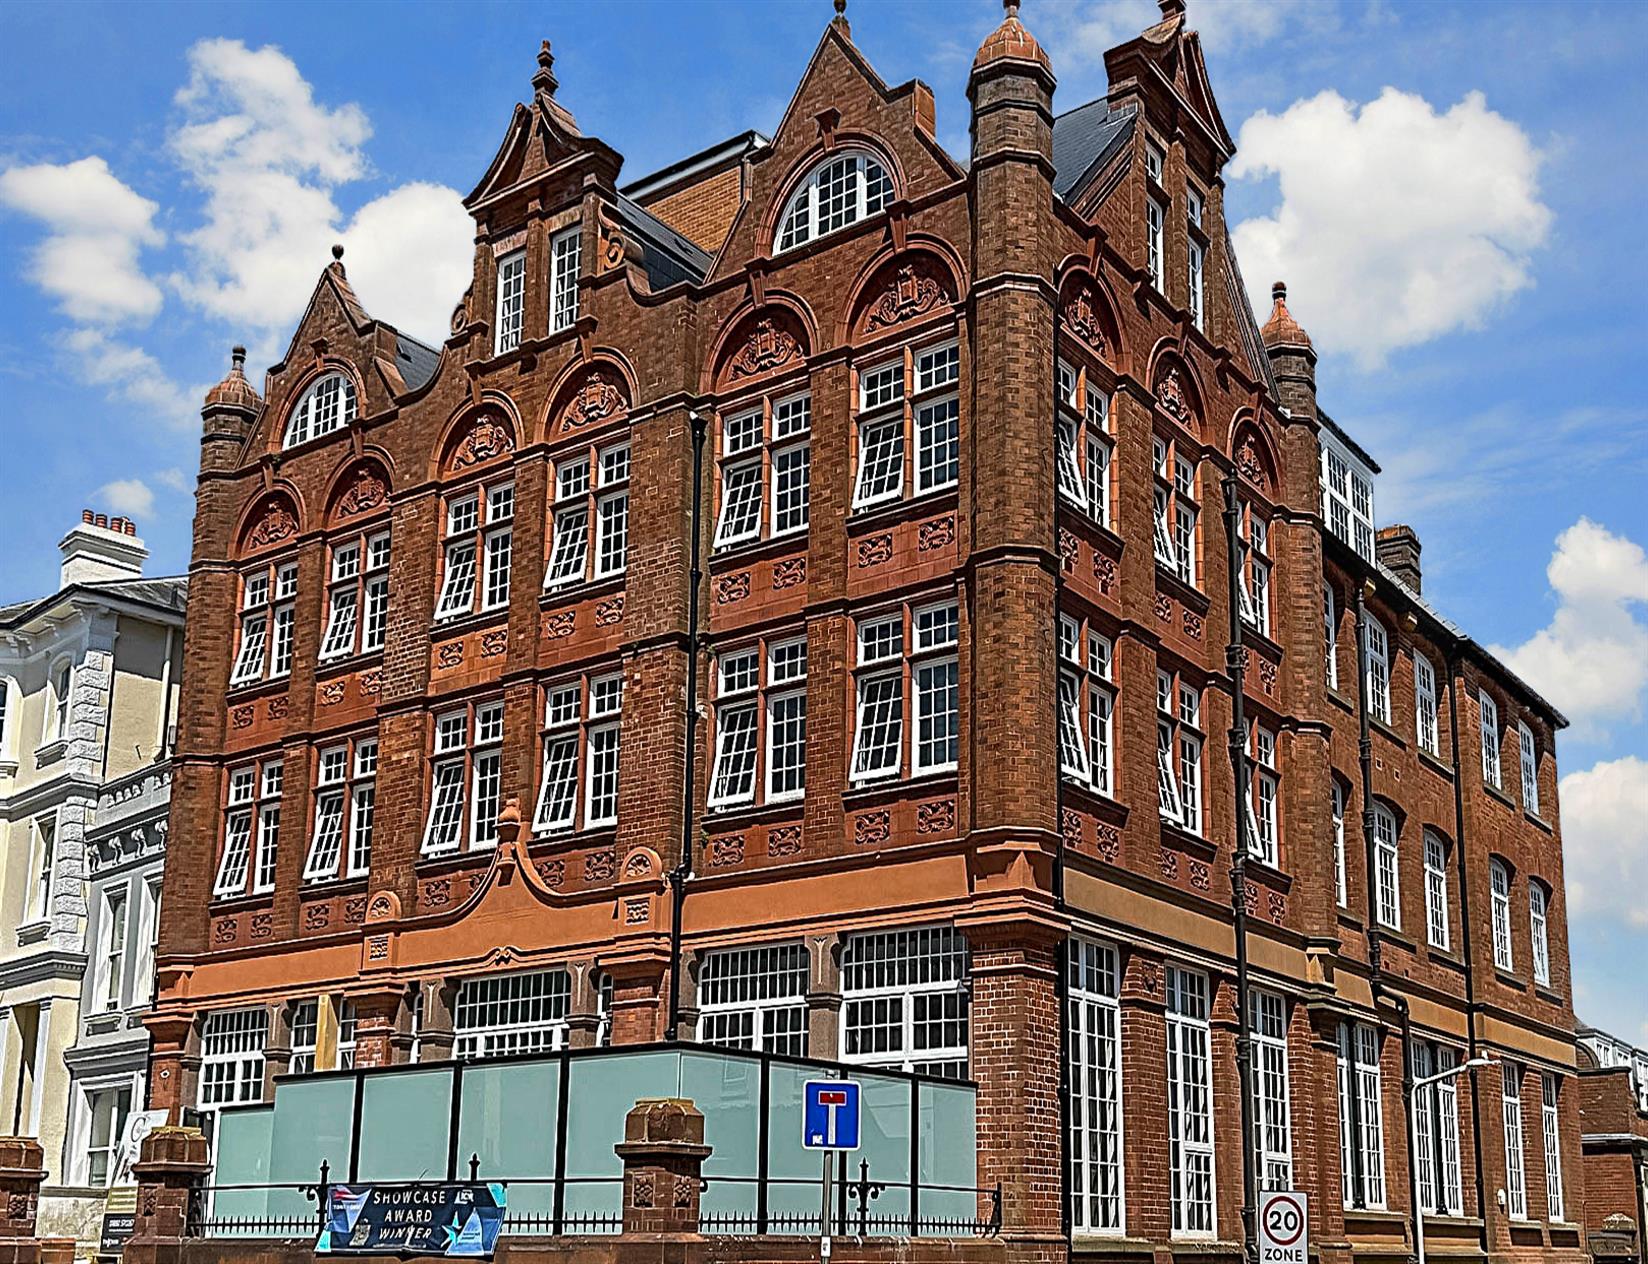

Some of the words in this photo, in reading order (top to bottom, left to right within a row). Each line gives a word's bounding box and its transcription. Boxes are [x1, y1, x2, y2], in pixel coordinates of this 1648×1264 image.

[373, 1190, 446, 1205] SHOWCASE
[384, 1209, 433, 1223] AWARD
[1269, 1210, 1298, 1232] 20
[379, 1226, 432, 1240] WINNER
[1264, 1248, 1303, 1262] ZONE
